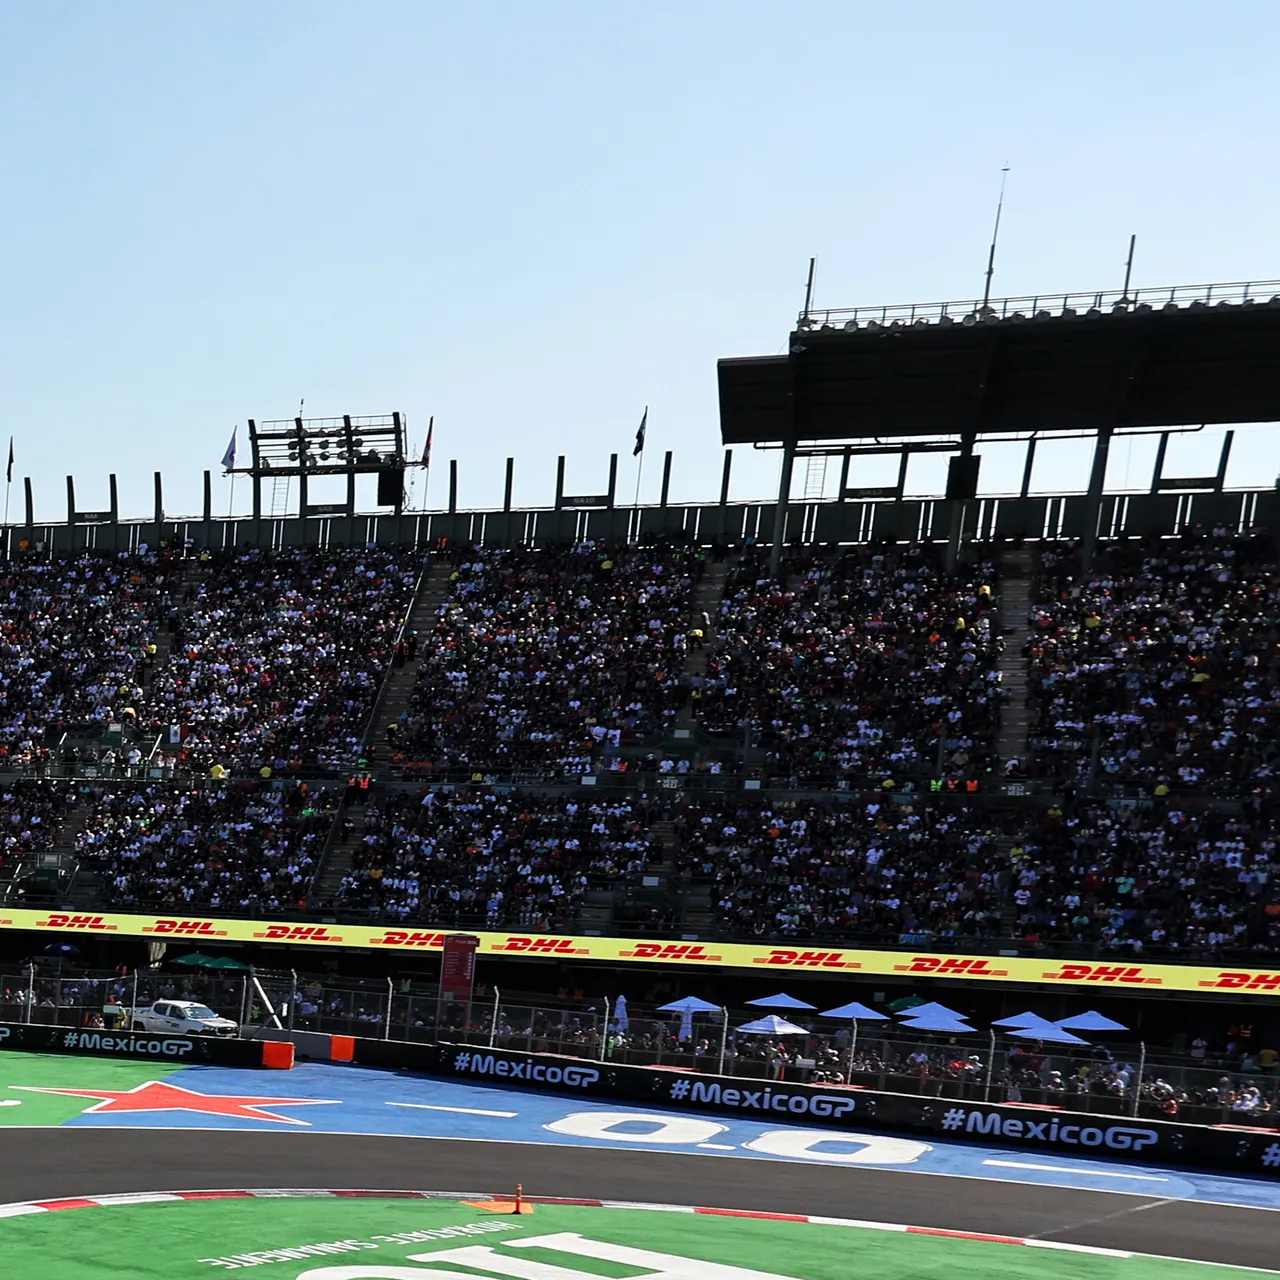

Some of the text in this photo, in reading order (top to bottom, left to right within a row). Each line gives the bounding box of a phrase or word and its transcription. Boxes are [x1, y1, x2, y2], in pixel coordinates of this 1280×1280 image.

[47, 915, 106, 929] DHL
[155, 920, 216, 935] DHL
[266, 926, 330, 941] DHL
[505, 937, 575, 953] DHL
[634, 944, 707, 960] DHL
[768, 950, 846, 967] DHL
[909, 957, 991, 975] DHL
[1058, 965, 1145, 983] DHL
[1216, 973, 1280, 990] DH
[63, 1032, 194, 1056] #MexicoGP
[453, 1052, 600, 1088] #MexicoGP
[669, 1078, 856, 1118] #MexicoGP
[941, 1107, 1159, 1151] #MexicoGP
[197, 1239, 380, 1270] SANAMENTE
